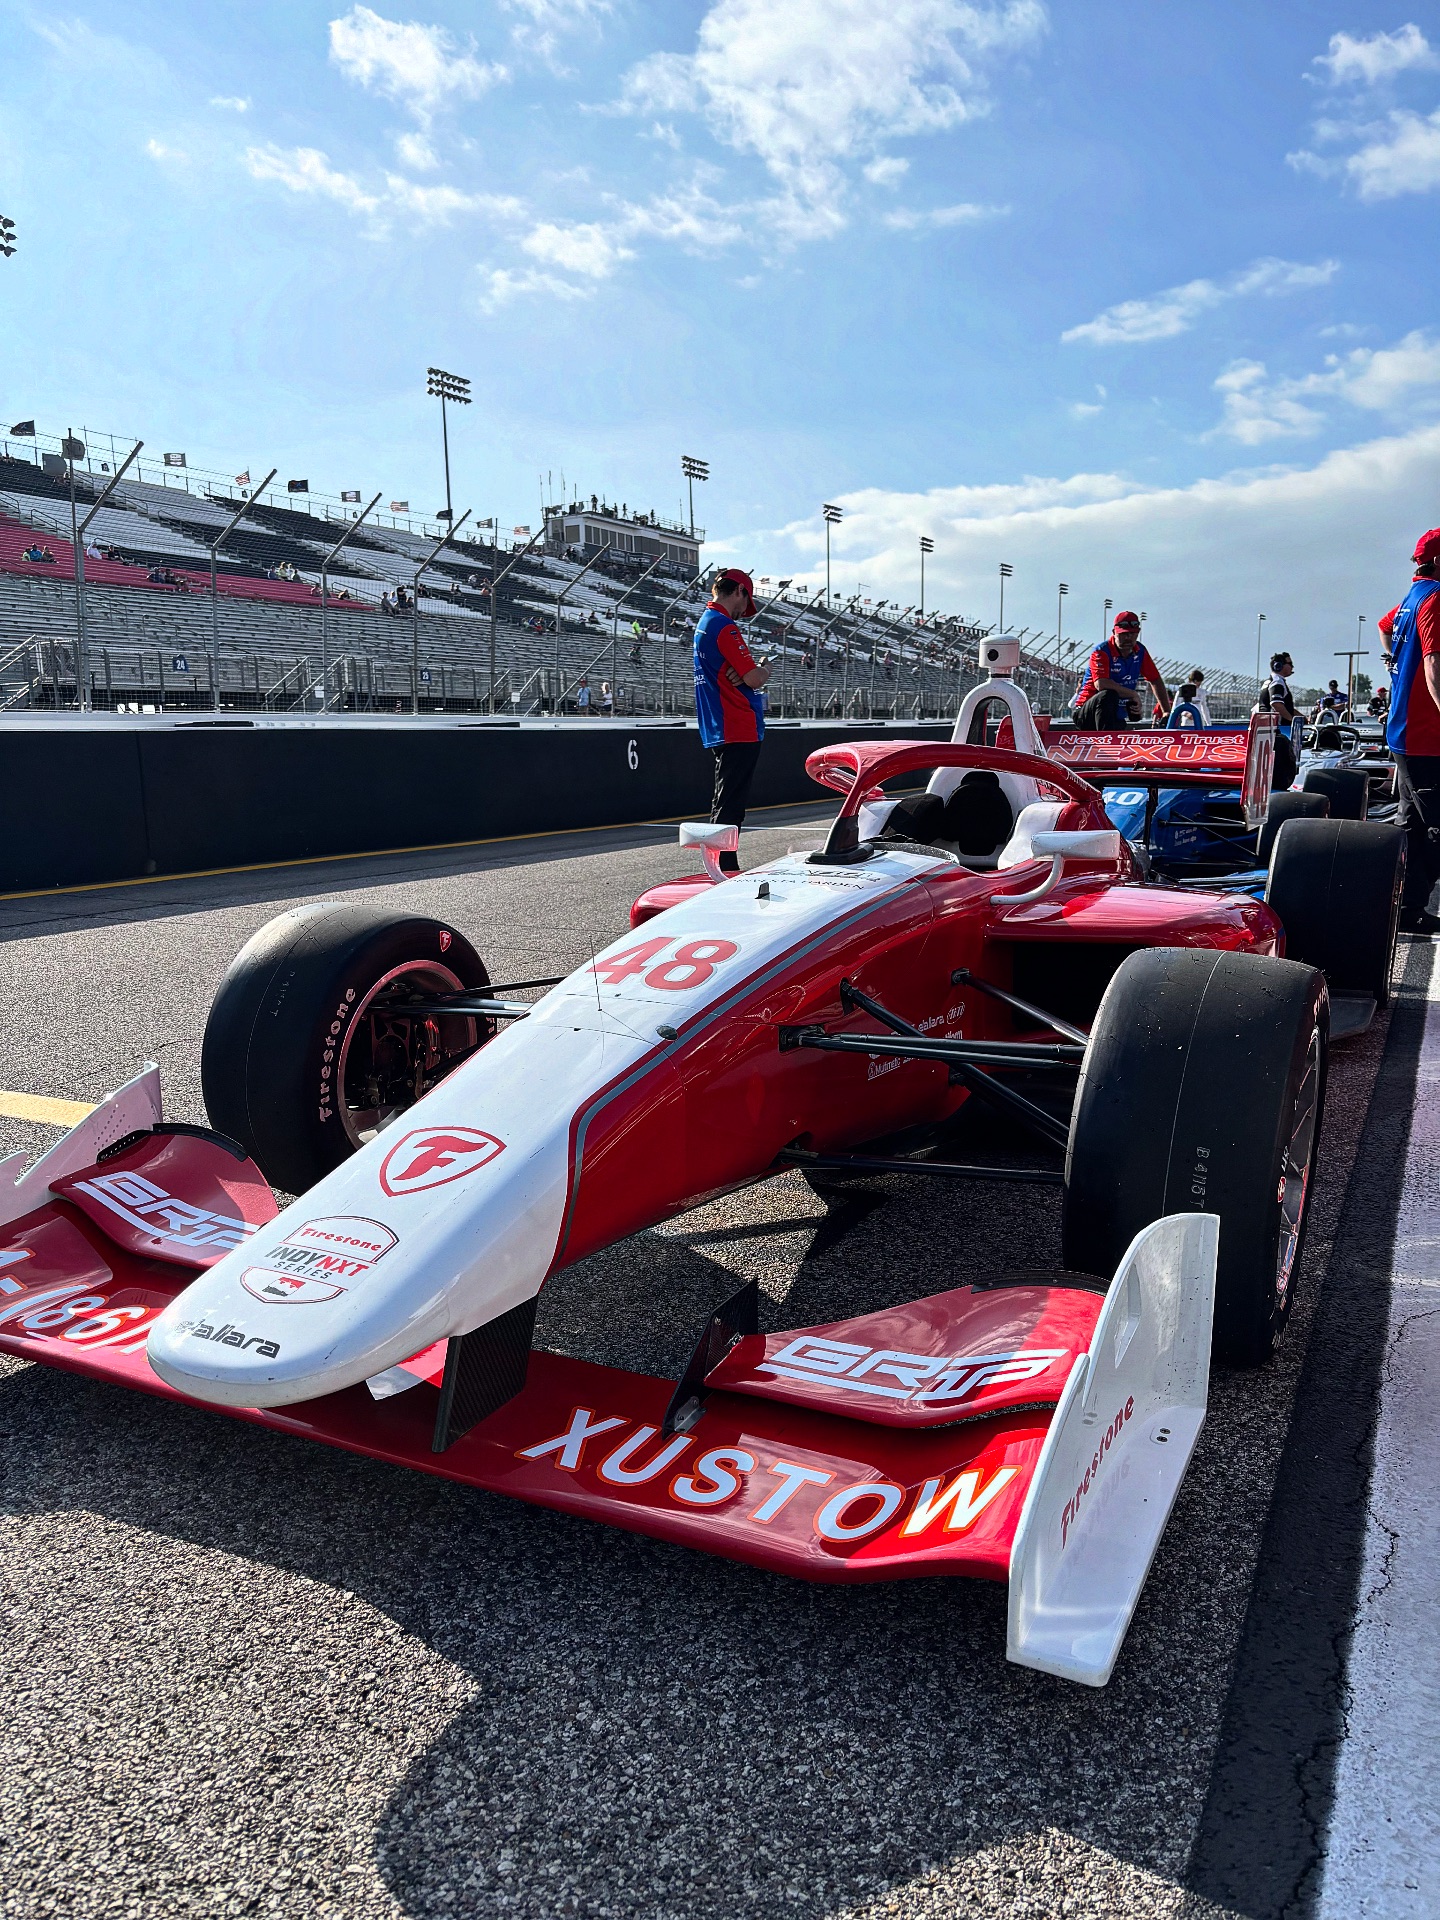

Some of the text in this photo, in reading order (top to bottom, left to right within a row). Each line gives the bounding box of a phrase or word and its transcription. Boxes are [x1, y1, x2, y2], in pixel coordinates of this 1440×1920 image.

[1046, 744, 1248, 762] NEXUS
[1059, 734, 1246, 745] Next Time Trust
[627, 739, 639, 770] 6
[585, 936, 741, 992] 48
[318, 987, 356, 1123] Firestone
[300, 1227, 383, 1252] Firestone
[273, 1260, 333, 1280] SERIES
[1060, 1395, 1135, 1551] Firestone
